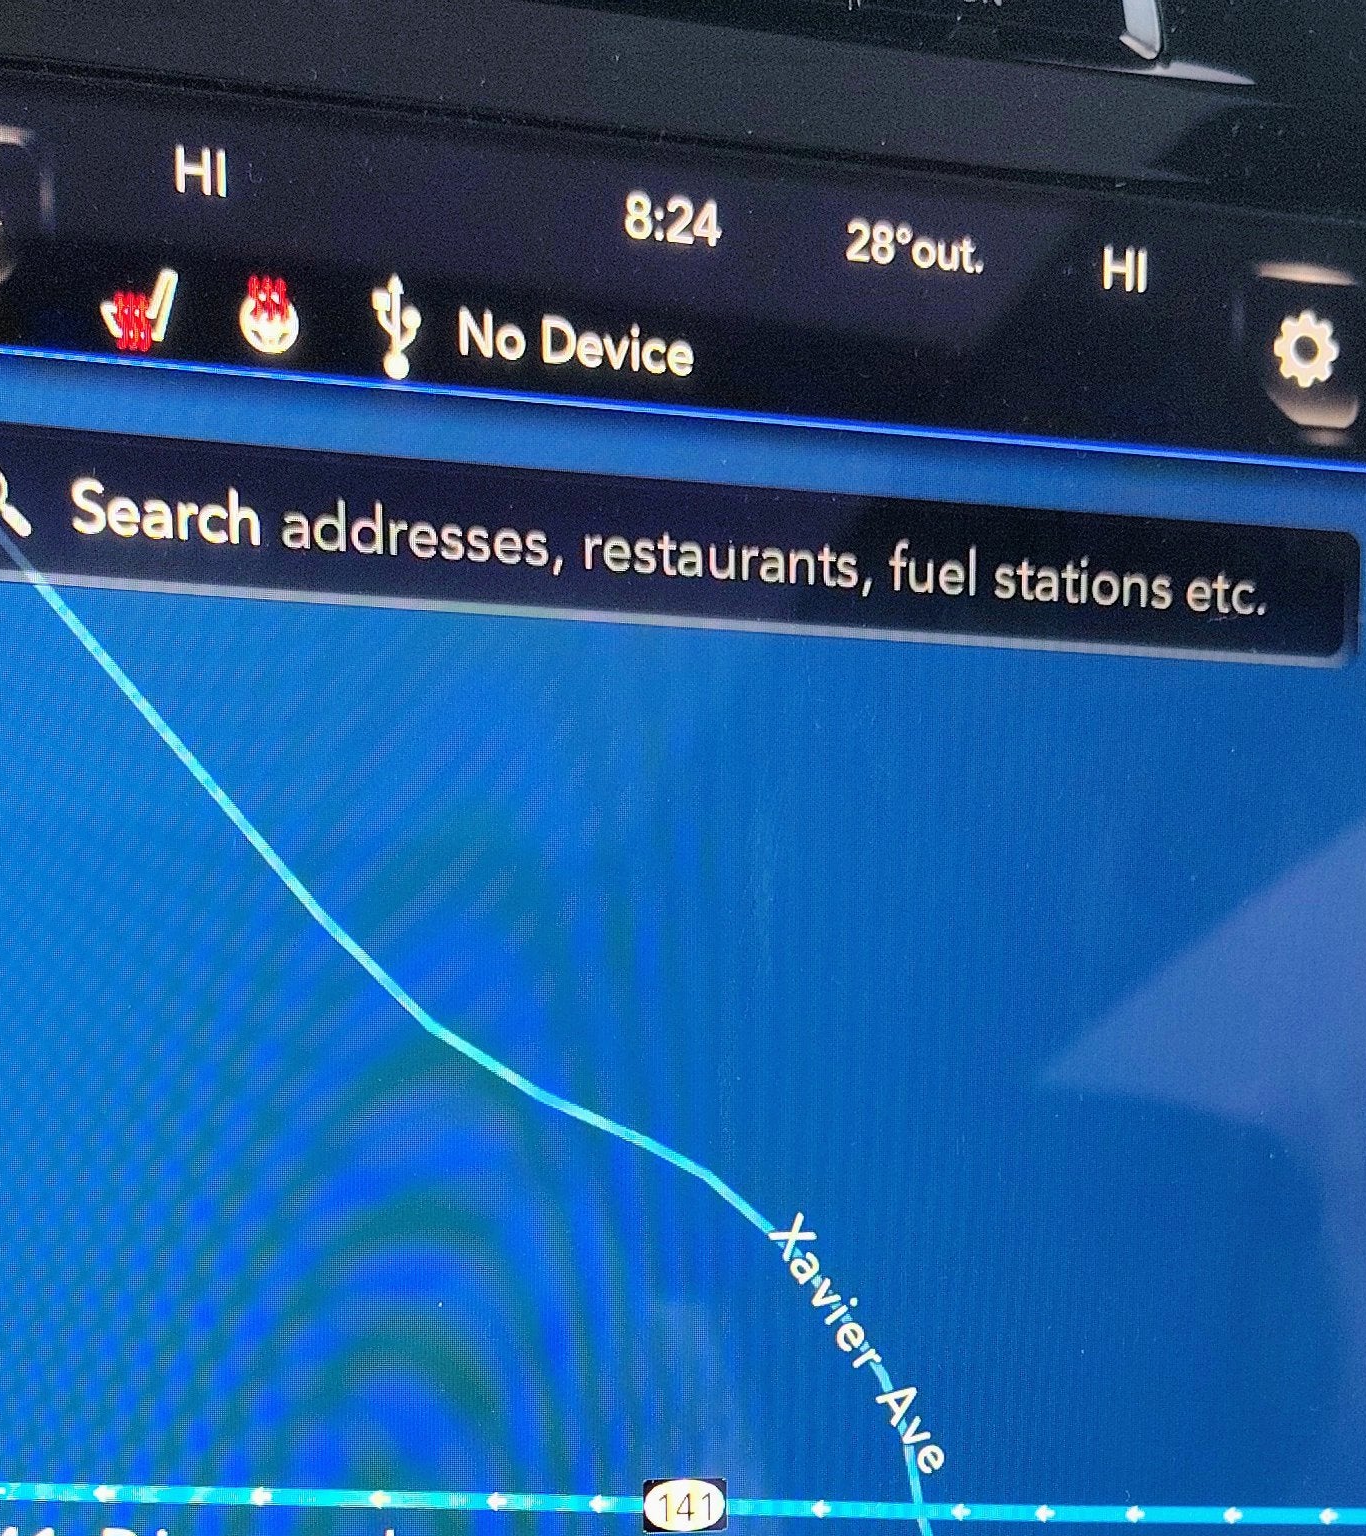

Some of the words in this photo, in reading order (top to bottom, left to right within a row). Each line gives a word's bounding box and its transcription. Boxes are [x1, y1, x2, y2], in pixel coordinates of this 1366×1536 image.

[175, 145, 227, 197] HI
[625, 191, 722, 248] 8:24
[1103, 244, 1148, 294] HI
[458, 306, 526, 361] No
[541, 314, 695, 379] Device
[71, 478, 260, 547] Search
[282, 498, 564, 575] addresses,
[583, 527, 873, 600] restaurants,
[889, 540, 976, 597] fuel
[994, 557, 1172, 611] stations
[1187, 573, 1268, 617] etc.
[769, 1212, 882, 1368] Xavier
[876, 1386, 945, 1474] Ave
[659, 1492, 714, 1522] 141
